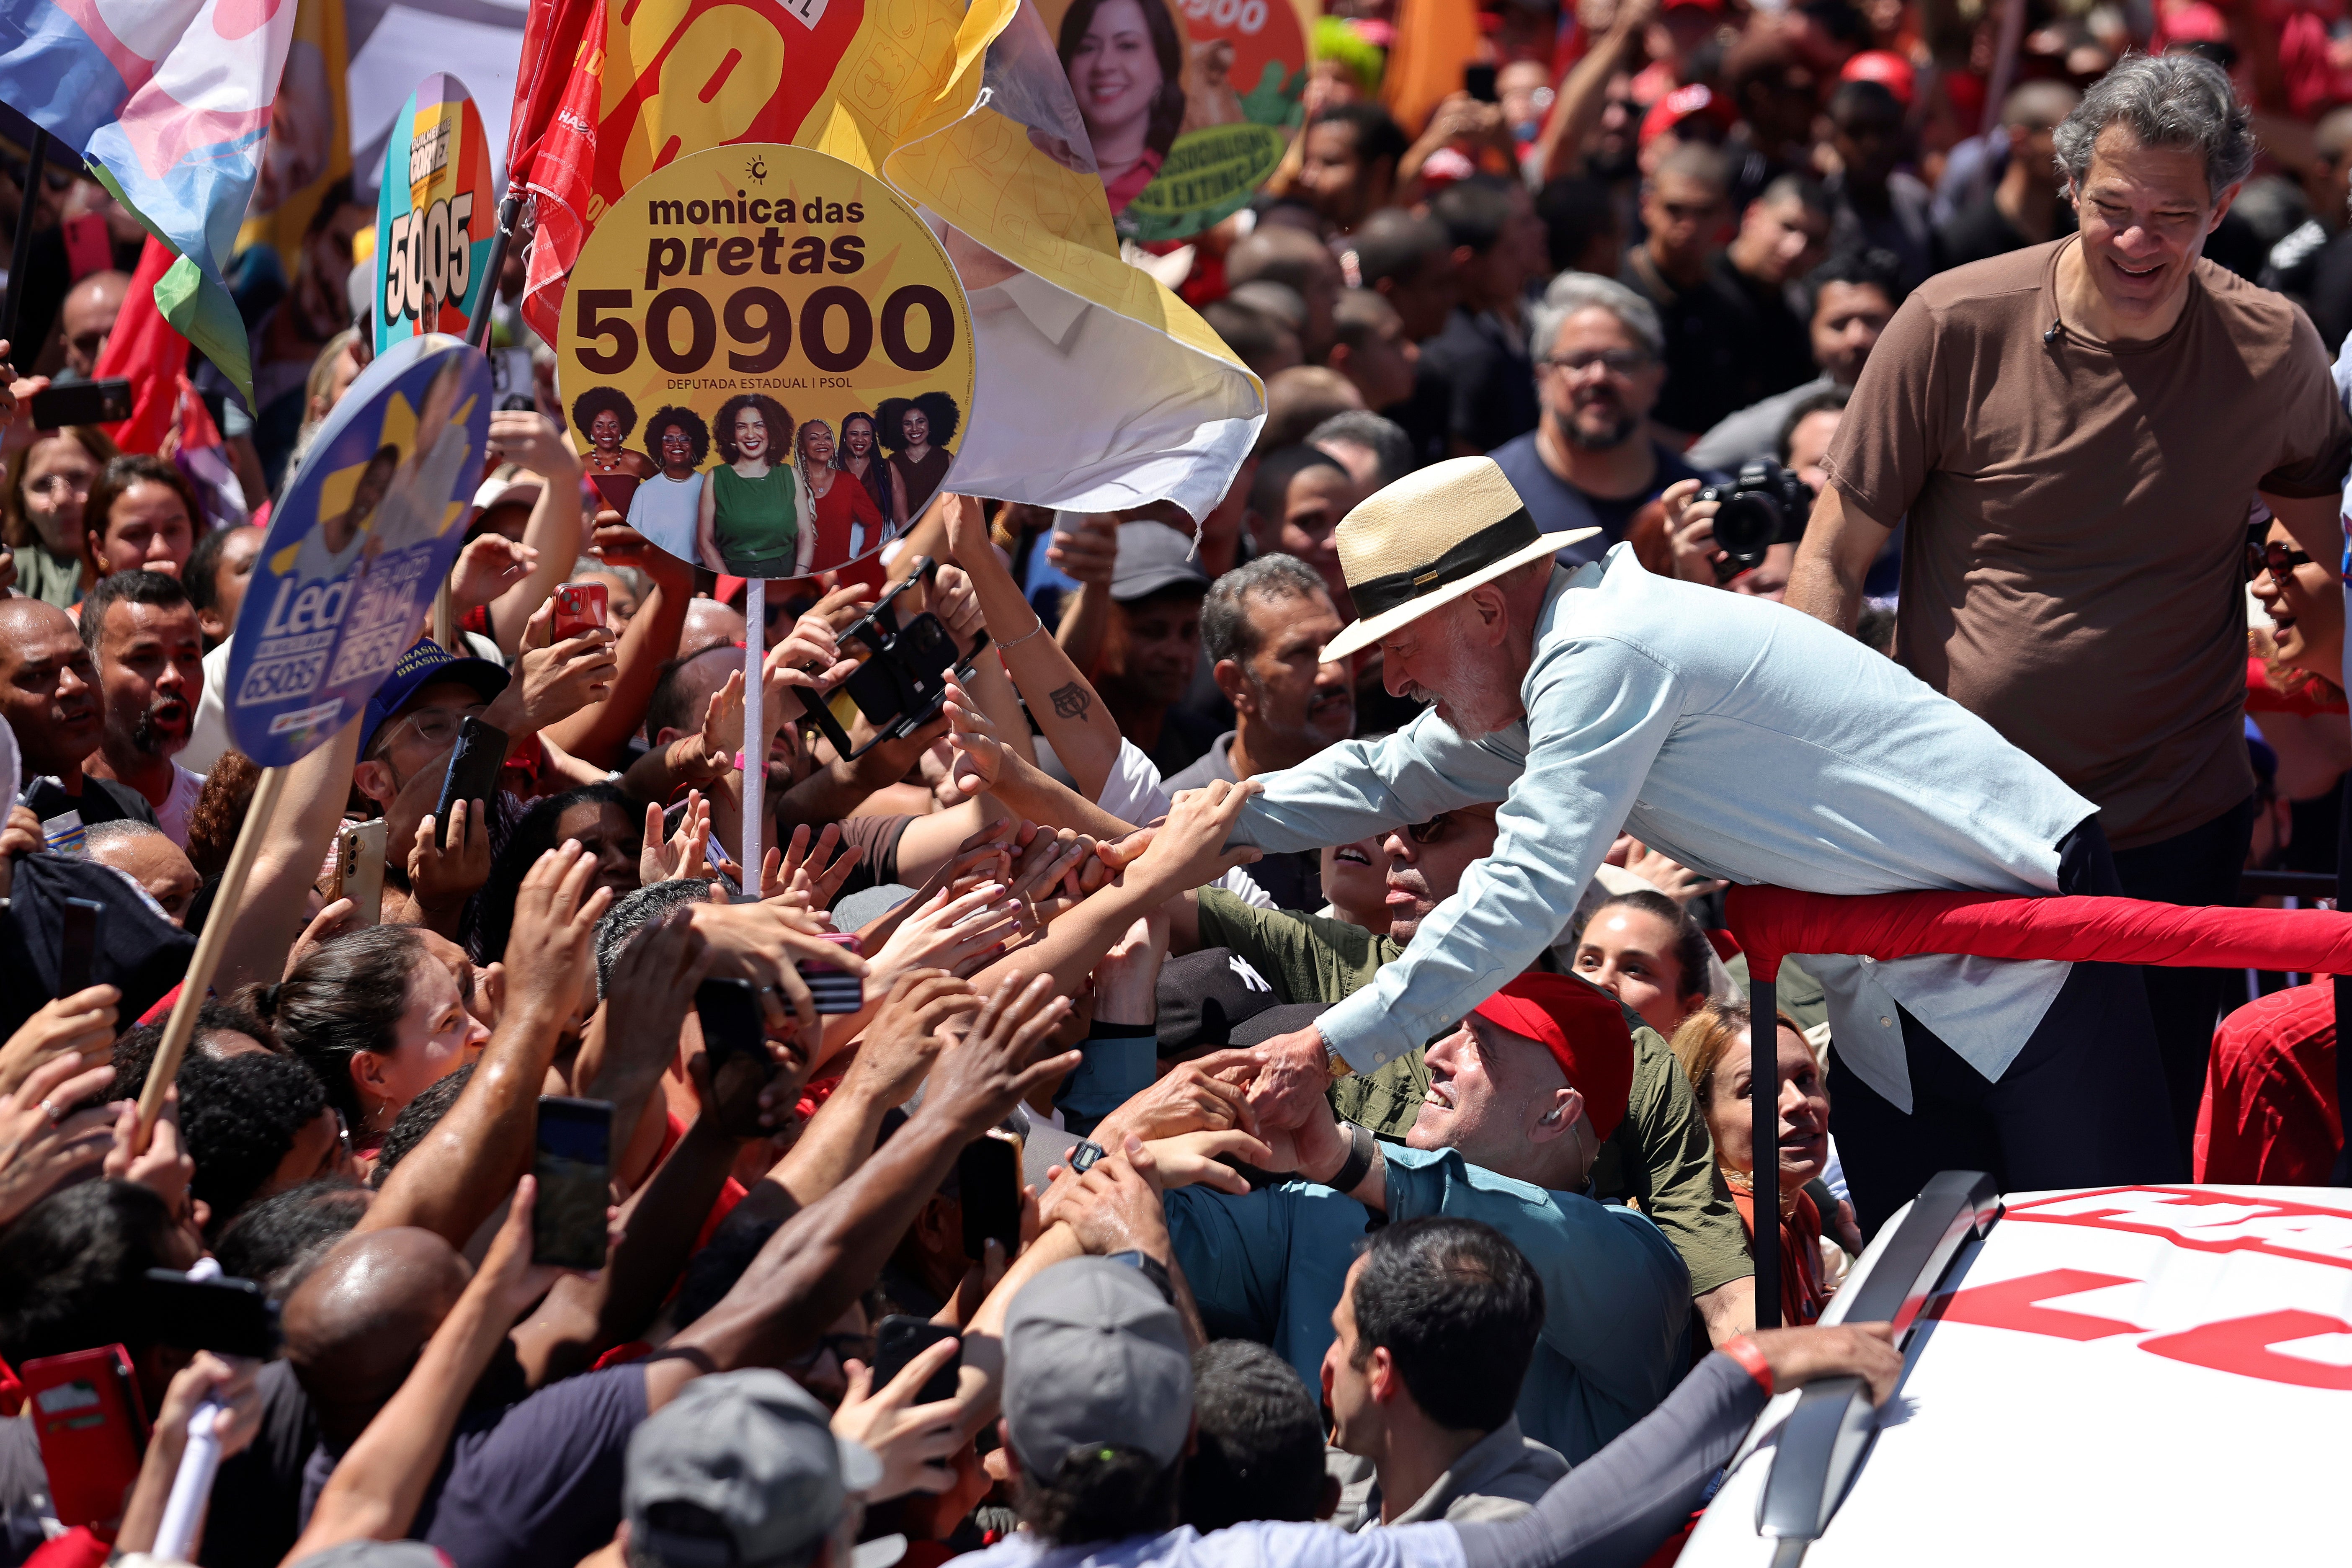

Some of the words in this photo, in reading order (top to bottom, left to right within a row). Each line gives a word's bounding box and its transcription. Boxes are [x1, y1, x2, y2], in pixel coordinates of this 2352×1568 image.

[410, 132, 449, 184] CORTEZ
[649, 190, 796, 225] monica
[803, 196, 864, 224] das
[387, 192, 473, 318] 5005
[645, 227, 865, 290] pretas
[923, 231, 932, 242] CNPJ
[575, 284, 955, 375] 50900
[667, 379, 737, 389] DEPUTADA
[740, 378, 808, 389] ESTADUAL
[820, 377, 853, 388] PSOL
